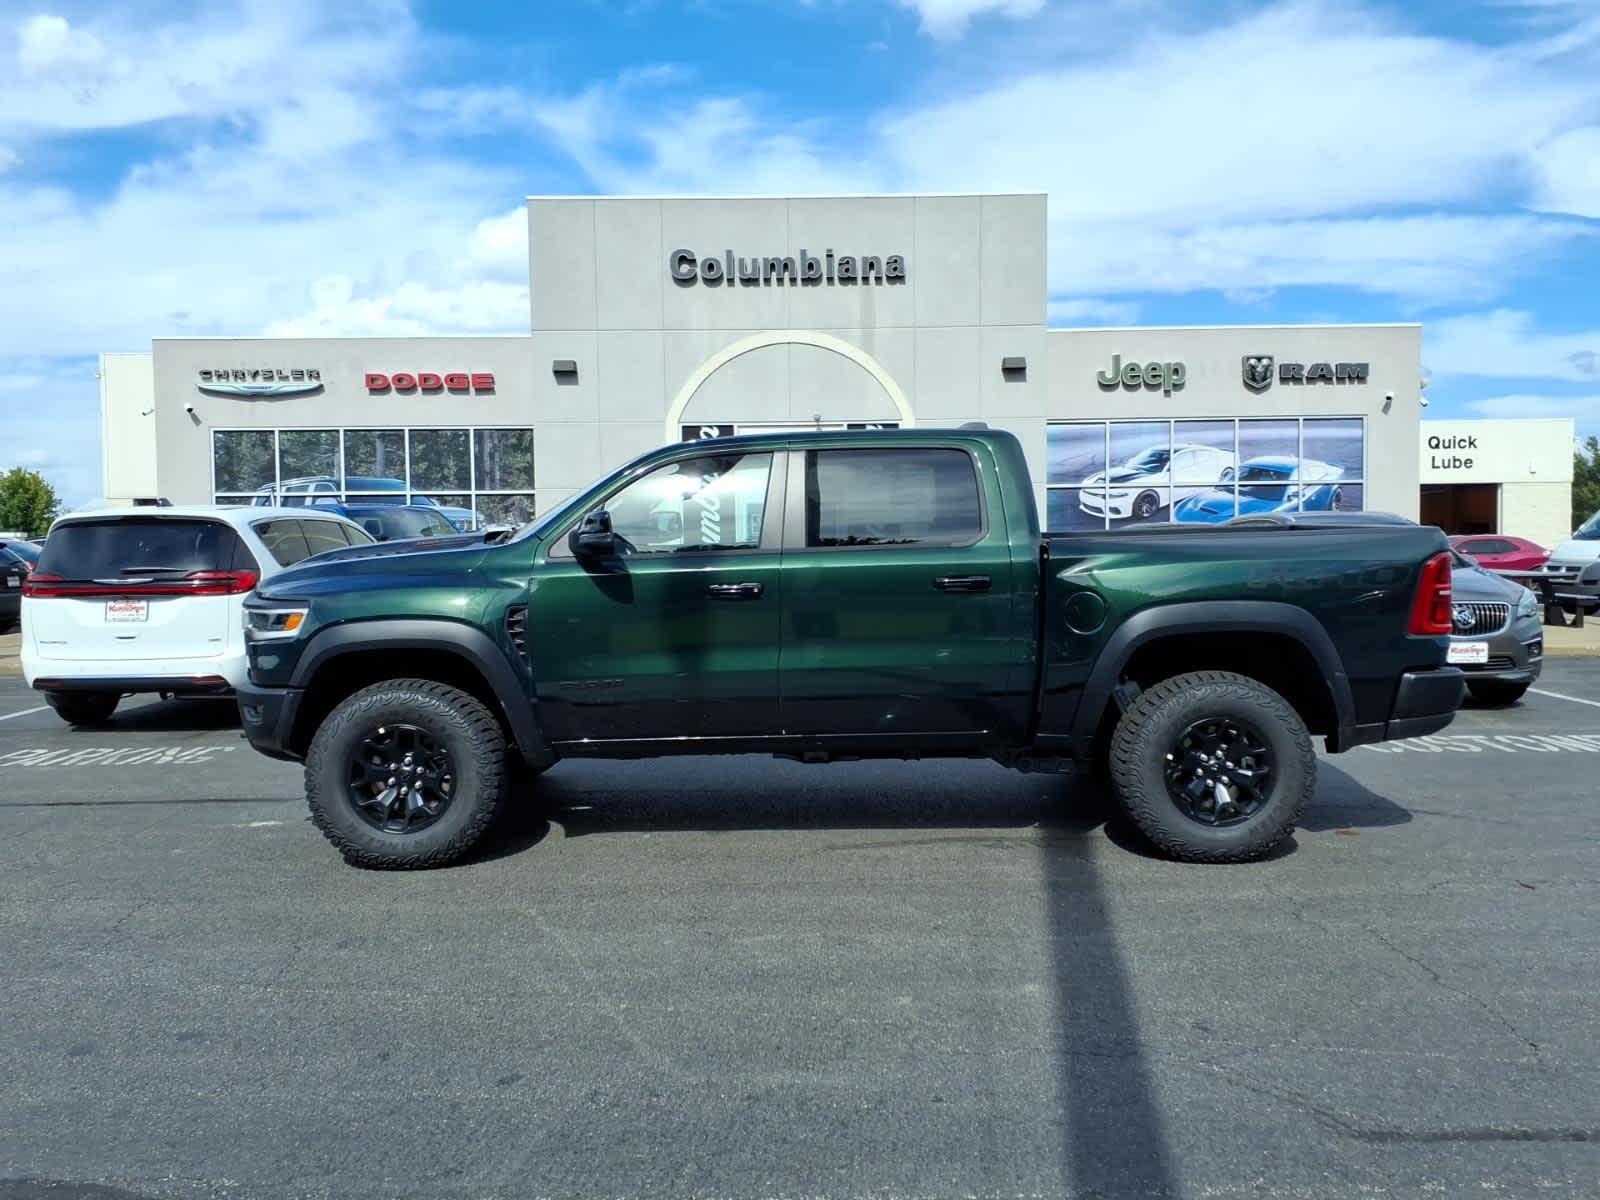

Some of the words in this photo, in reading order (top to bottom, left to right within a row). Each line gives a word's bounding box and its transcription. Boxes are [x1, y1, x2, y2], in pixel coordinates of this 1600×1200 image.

[670, 248, 905, 286] Columbiana
[199, 369, 321, 381] CHRYSLER
[365, 373, 495, 392] DODGE
[1096, 353, 1186, 393] Jeep
[1279, 362, 1369, 384] RAM
[1428, 435, 1478, 449] Quick
[1431, 455, 1473, 469] Lube
[0, 746, 236, 767] PARKING
